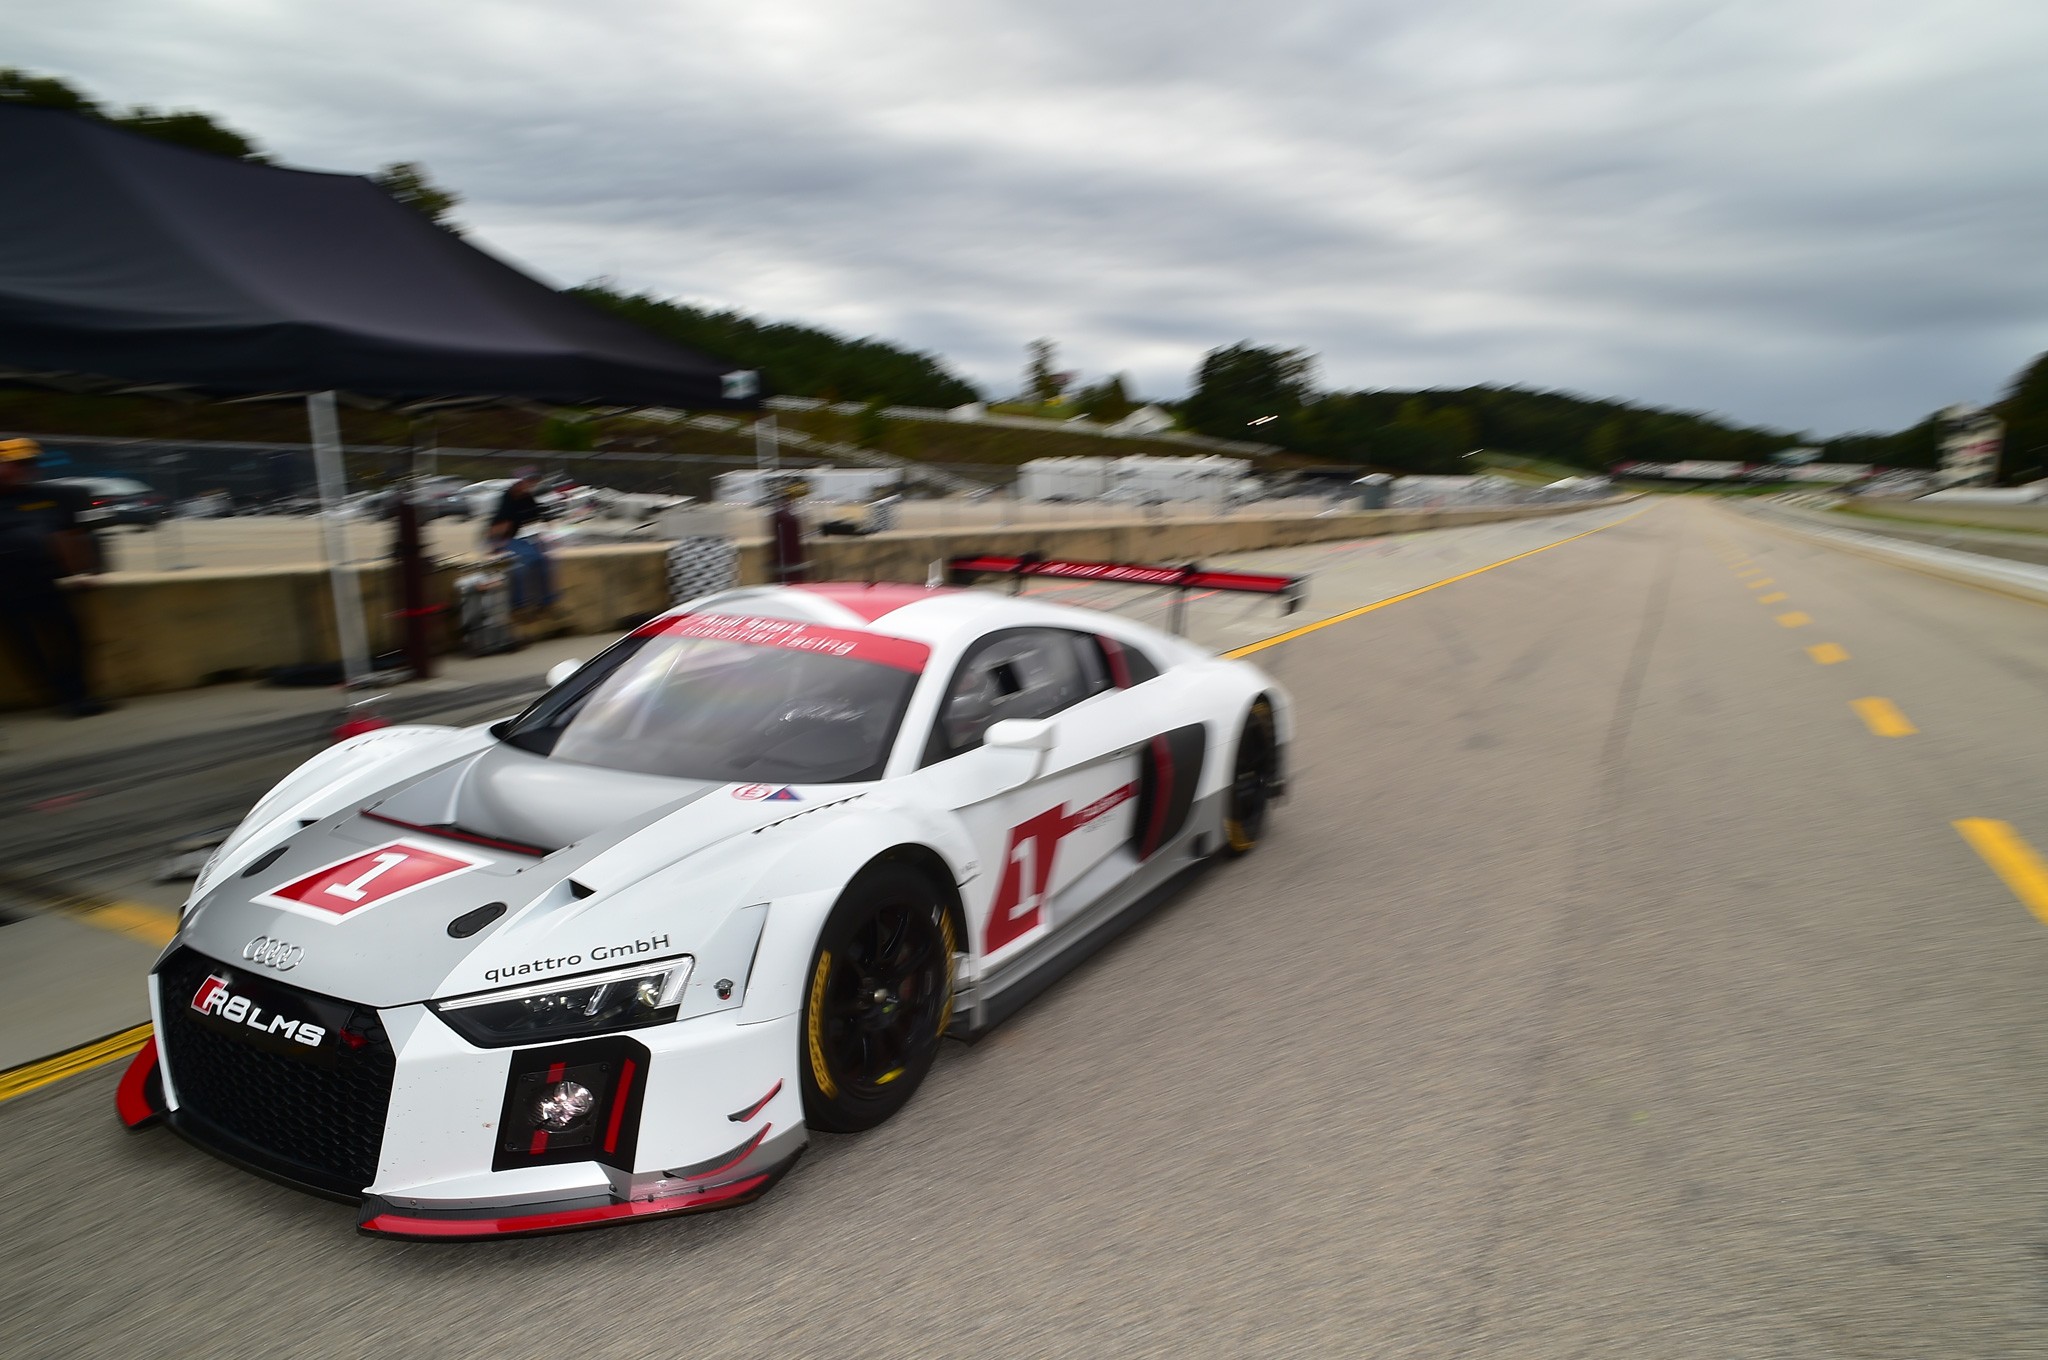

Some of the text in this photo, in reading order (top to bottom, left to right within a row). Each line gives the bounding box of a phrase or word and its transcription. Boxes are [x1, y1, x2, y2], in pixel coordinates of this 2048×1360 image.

[776, 633, 858, 656] racing
[323, 851, 410, 903] 1
[1008, 834, 1044, 922] 1
[484, 933, 671, 983] quattro GmbH
